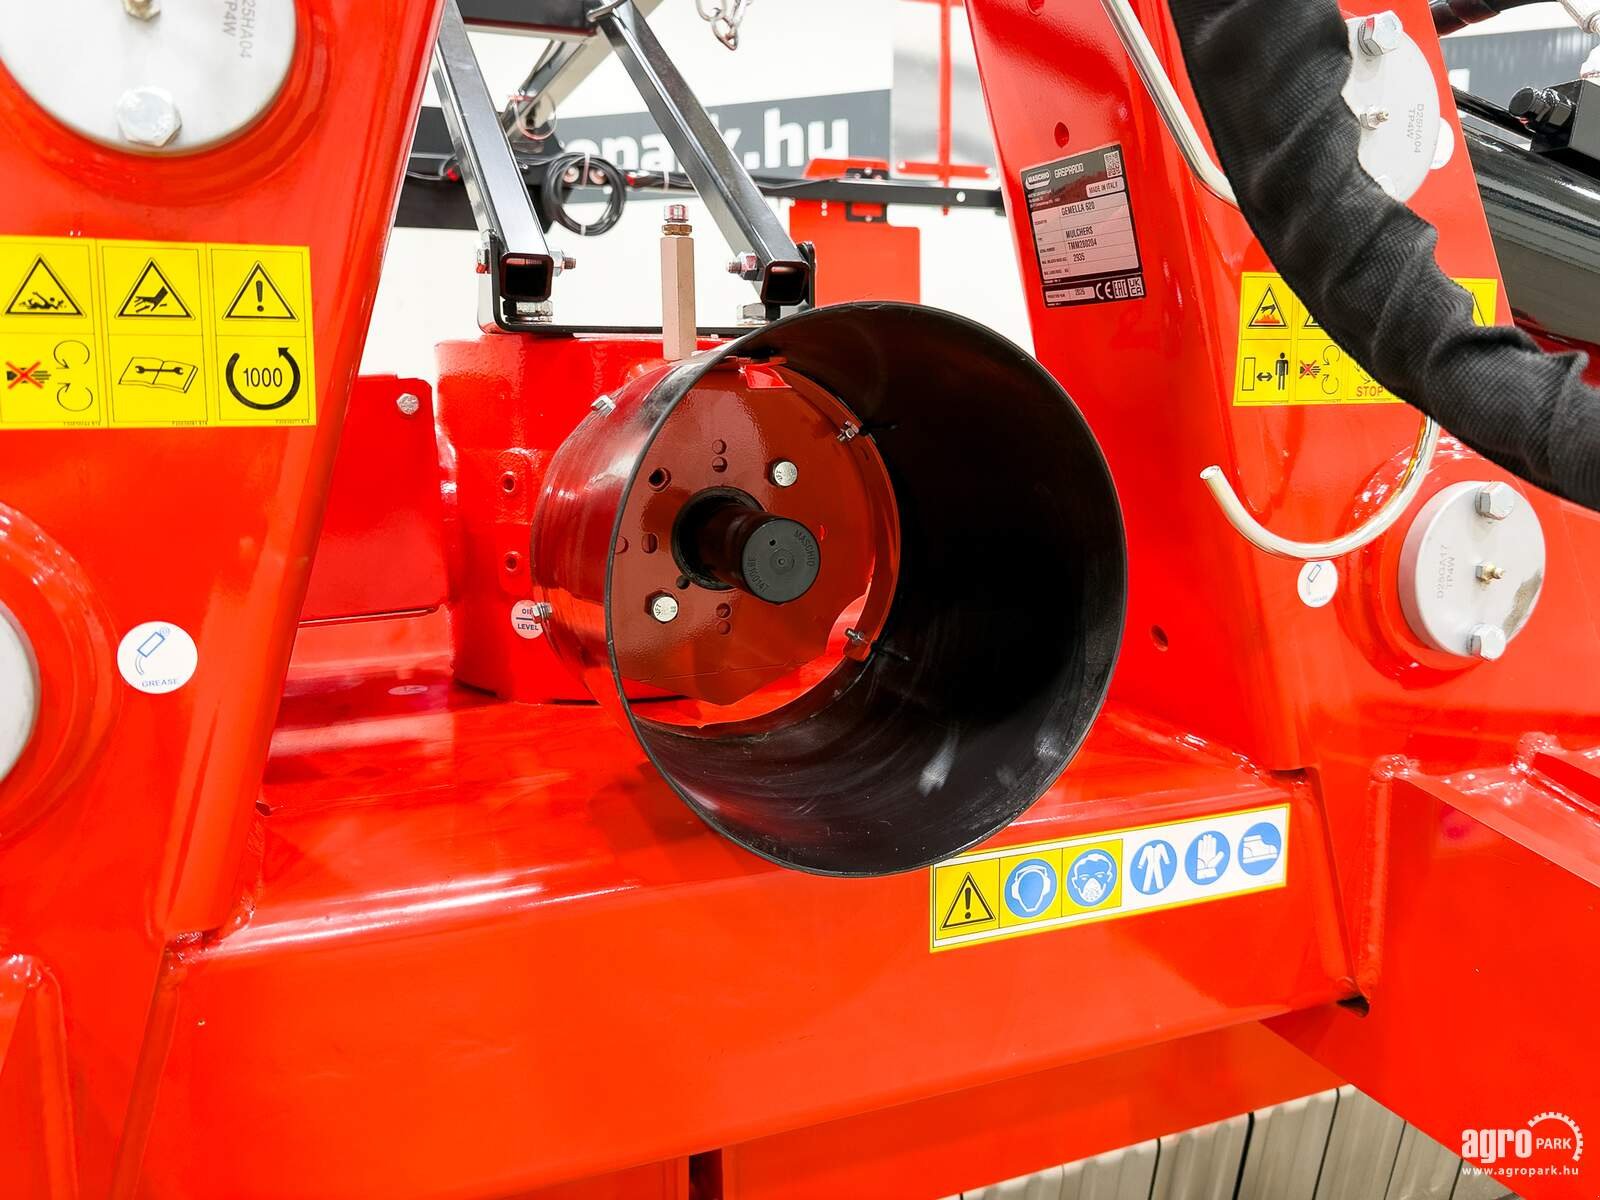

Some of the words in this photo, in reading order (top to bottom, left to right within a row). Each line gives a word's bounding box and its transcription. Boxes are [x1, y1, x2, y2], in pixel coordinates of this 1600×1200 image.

[1061, 203, 1085, 216] GEMELLA
[1066, 226, 1094, 239] MULCHERS
[243, 367, 283, 388] 1000
[1356, 385, 1384, 397] STOP
[517, 623, 539, 631] LEVEL
